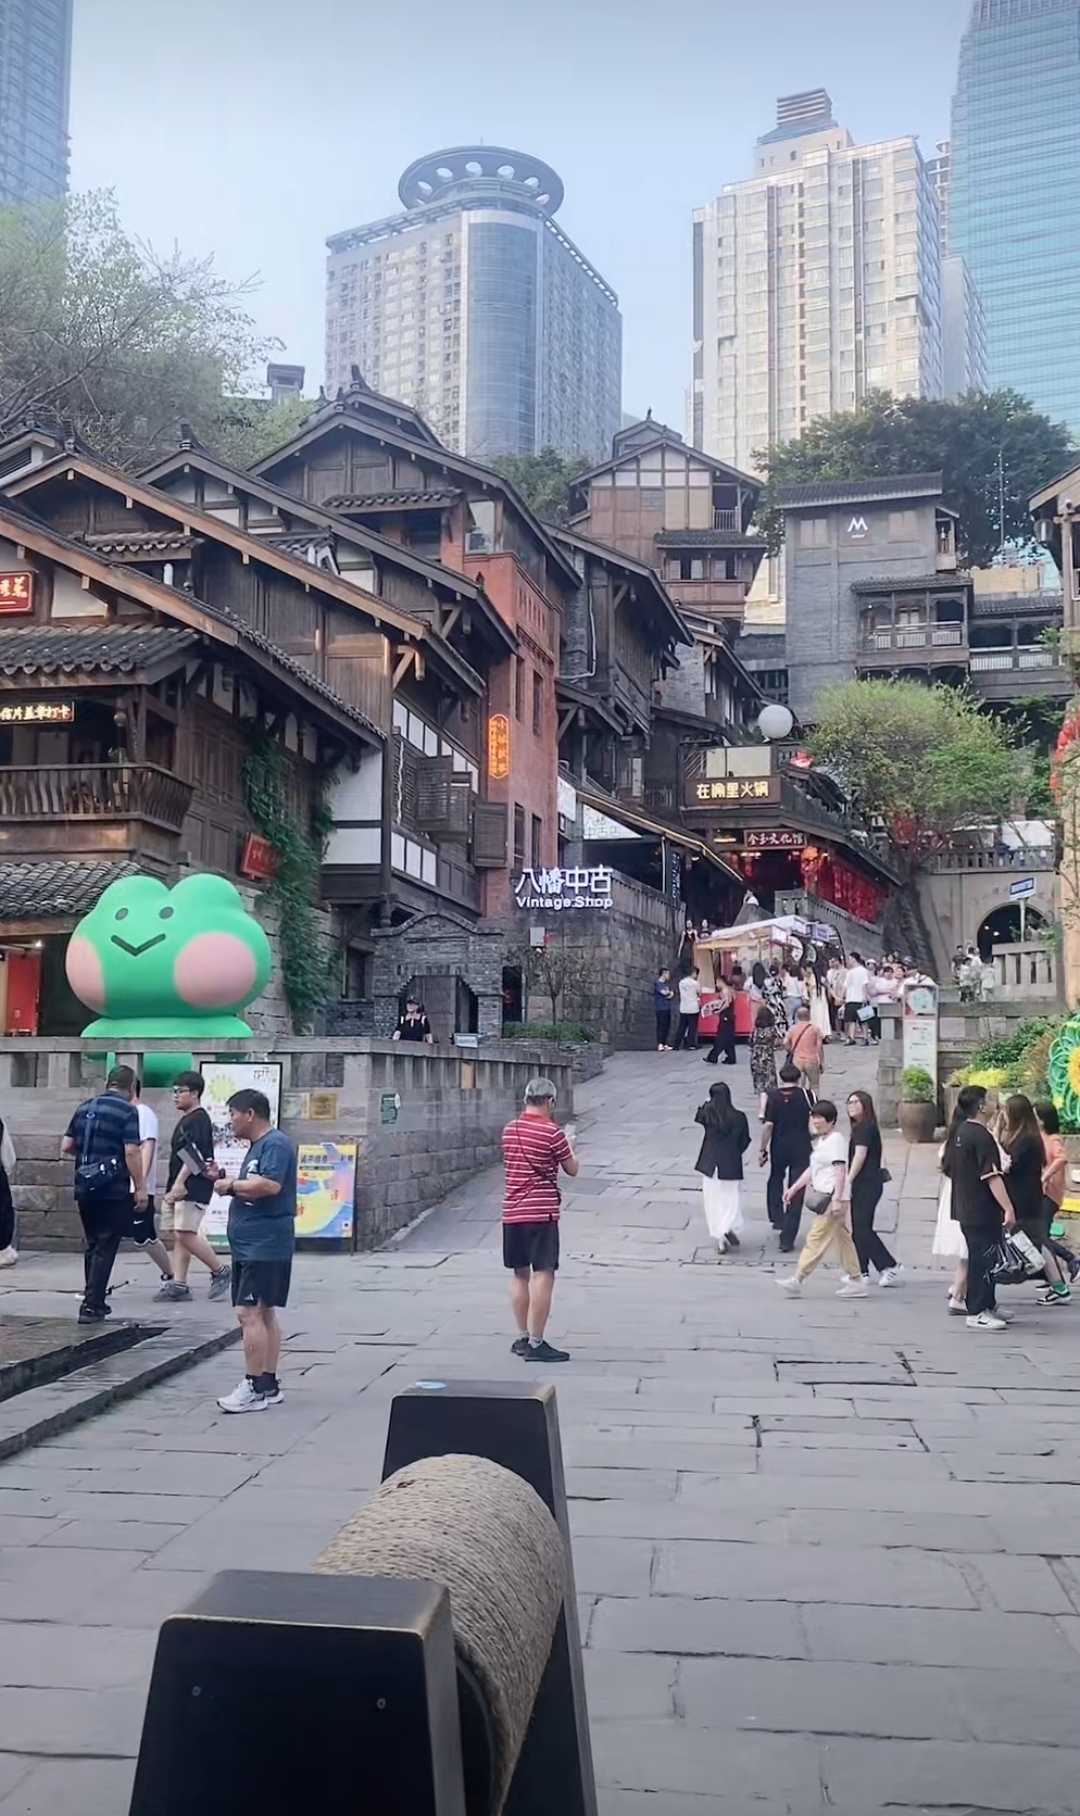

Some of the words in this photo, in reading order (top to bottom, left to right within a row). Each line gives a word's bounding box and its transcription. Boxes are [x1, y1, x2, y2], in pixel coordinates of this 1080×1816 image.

[514, 863, 614, 895] 八幡中古
[516, 896, 571, 910] Vintage
[575, 896, 613, 909] Shop
